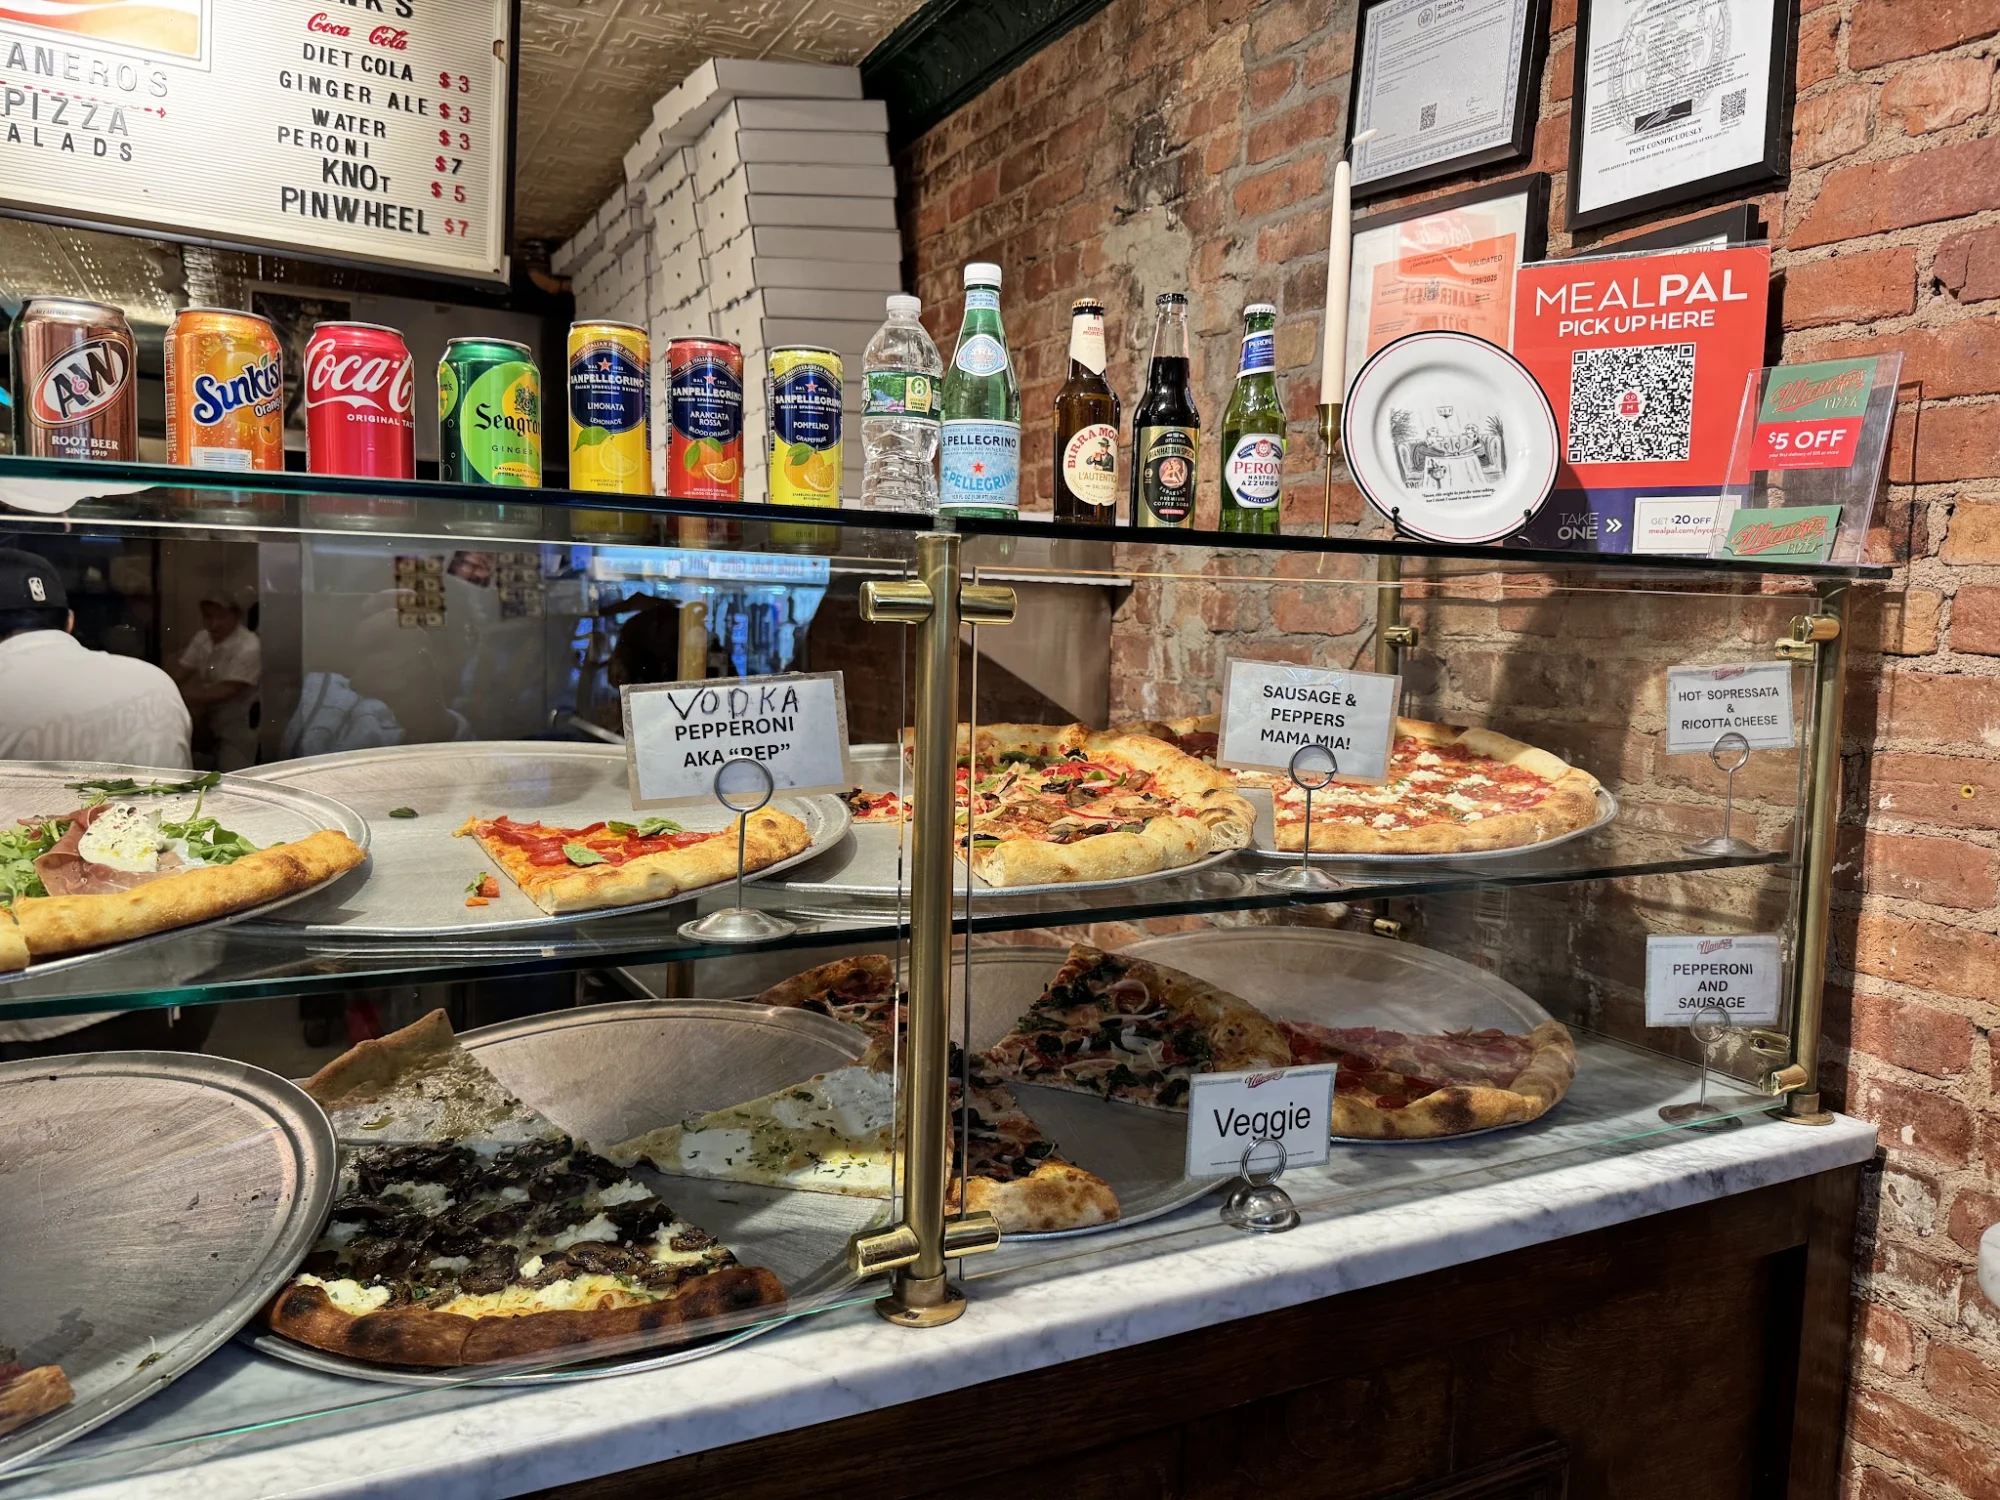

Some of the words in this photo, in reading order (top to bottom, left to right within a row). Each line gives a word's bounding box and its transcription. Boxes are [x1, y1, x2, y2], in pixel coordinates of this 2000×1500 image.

[307, 12, 350, 37] Coca
[368, 25, 409, 50] Cola
[303, 43, 353, 69] DIET
[361, 55, 414, 82] COLA
[279, 70, 372, 105] GINGER
[387, 92, 429, 116] ALE
[5, 87, 129, 136] PIZZA
[312, 108, 386, 138] WATER
[278, 126, 370, 159] PERONI
[322, 157, 391, 193] KNOT
[281, 186, 431, 236] PINWHEEL
[444, 218, 470, 238] $7
[1535, 269, 1748, 316] MEALPAL
[1558, 317, 1610, 338] PICK
[1613, 314, 1647, 333] UP
[1650, 309, 1716, 330] HERE
[51, 341, 119, 420] A&W
[194, 351, 282, 422] Sunkist
[570, 373, 645, 389] SANPELLEGRINO
[673, 387, 742, 402] SANPELLEGRINO
[775, 394, 842, 408] SANPELLEGRINO
[587, 402, 625, 412] LIMONATA
[346, 413, 400, 427] ORIGINAL
[474, 402, 541, 437] Seagra
[589, 416, 623, 425] LEMONADE
[689, 410, 730, 421] ARANCIATA
[698, 419, 722, 427] ROSSA
[793, 421, 830, 431] POMPELMO
[51, 435, 88, 447] ROOT
[90, 438, 119, 451] BEER
[942, 434, 1017, 449] S.PELLEGRINO
[1767, 431, 1789, 450] $5
[1794, 429, 1847, 449] OFF
[65, 447, 90, 455] SINCE
[91, 449, 108, 457] 1919
[492, 444, 533, 455] GINGER
[1067, 428, 1098, 469] BIRRA
[1158, 485, 1187, 496] ESPRESSO
[1559, 512, 1599, 526] TAKE
[1651, 517, 1669, 526] GET
[1671, 514, 1691, 525] $20
[1692, 517, 1711, 525] OFF
[1557, 526, 1598, 540] ONE
[1263, 684, 1342, 706] SAUSAGE
[1345, 693, 1358, 707] &
[1678, 690, 1701, 702] HOT
[1707, 686, 1779, 700] SOPRESSATA
[667, 685, 800, 721] VODKA
[1726, 703, 1735, 713] &
[1270, 707, 1345, 728] PEPPERS
[1681, 718, 1732, 730] RICOTTA
[1733, 715, 1778, 727] CHEESE
[674, 716, 795, 741] PEPPERONI
[1260, 728, 1310, 746] MAMA
[1315, 734, 1351, 750] MIA!
[683, 750, 725, 768] AKA
[1673, 963, 1753, 976] PEPPERONI
[1697, 980, 1728, 992] AND
[1678, 997, 1746, 1009] SAUSAGE
[1213, 1102, 1311, 1141] Veggie
